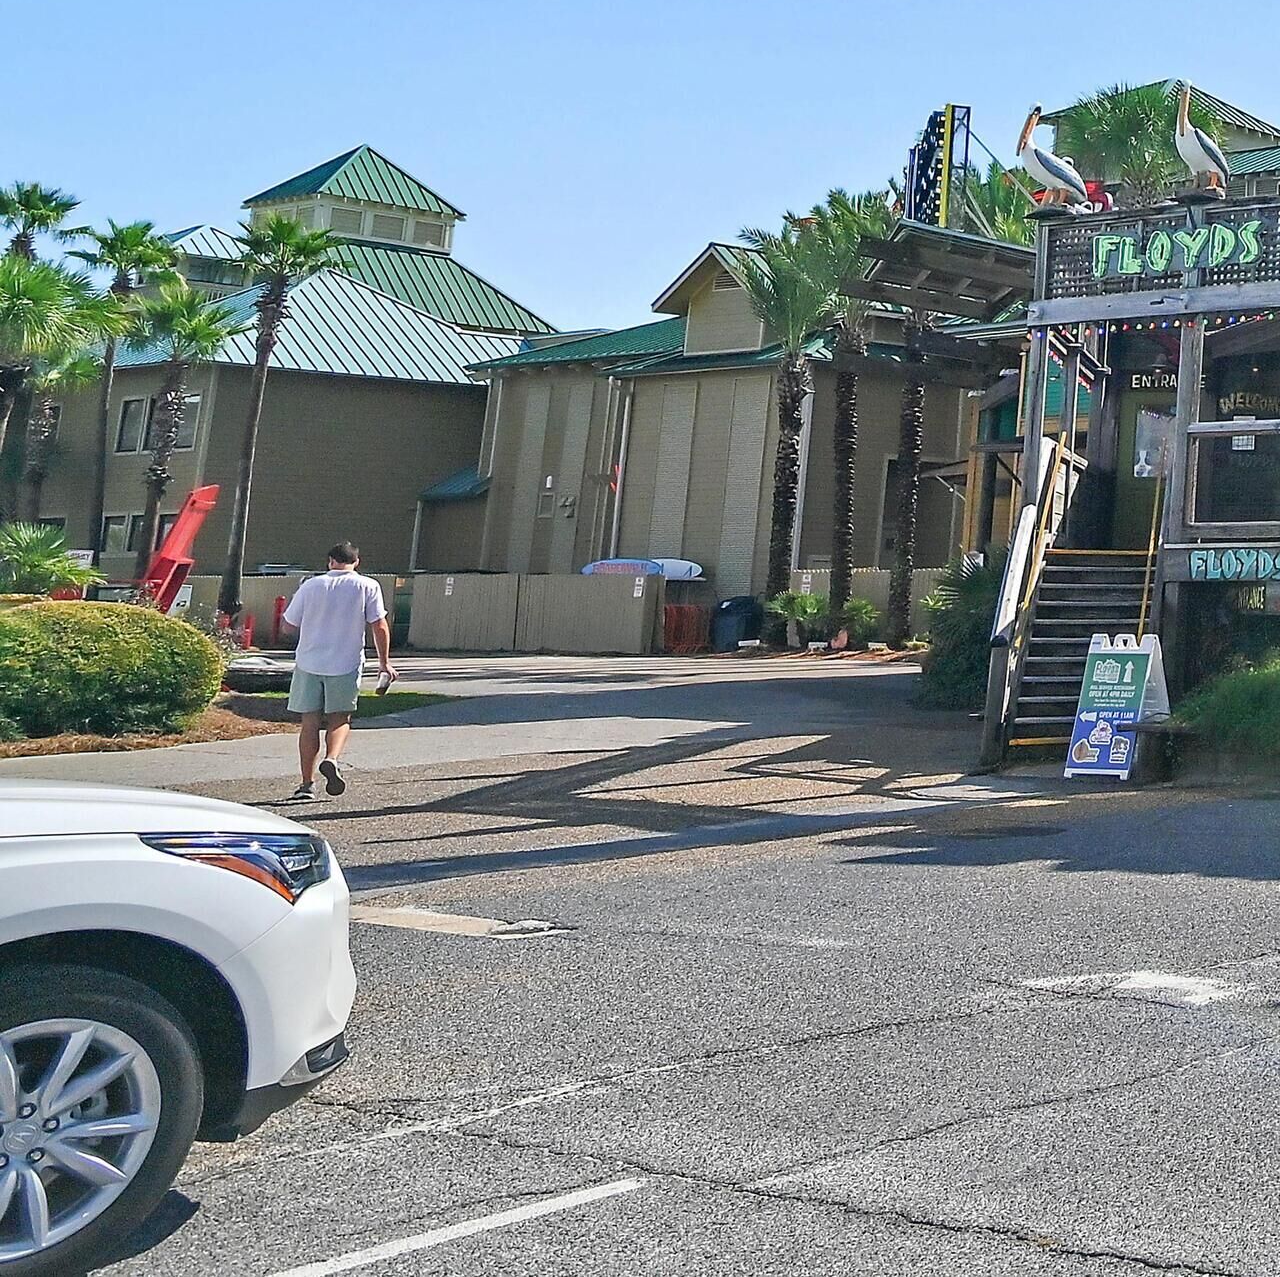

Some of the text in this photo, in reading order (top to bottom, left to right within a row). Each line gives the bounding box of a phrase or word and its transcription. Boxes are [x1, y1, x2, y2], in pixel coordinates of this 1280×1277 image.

[1092, 220, 1263, 278] FLOYDS
[1099, 711, 1113, 719] OPEN
[1113, 711, 1120, 719] AT
